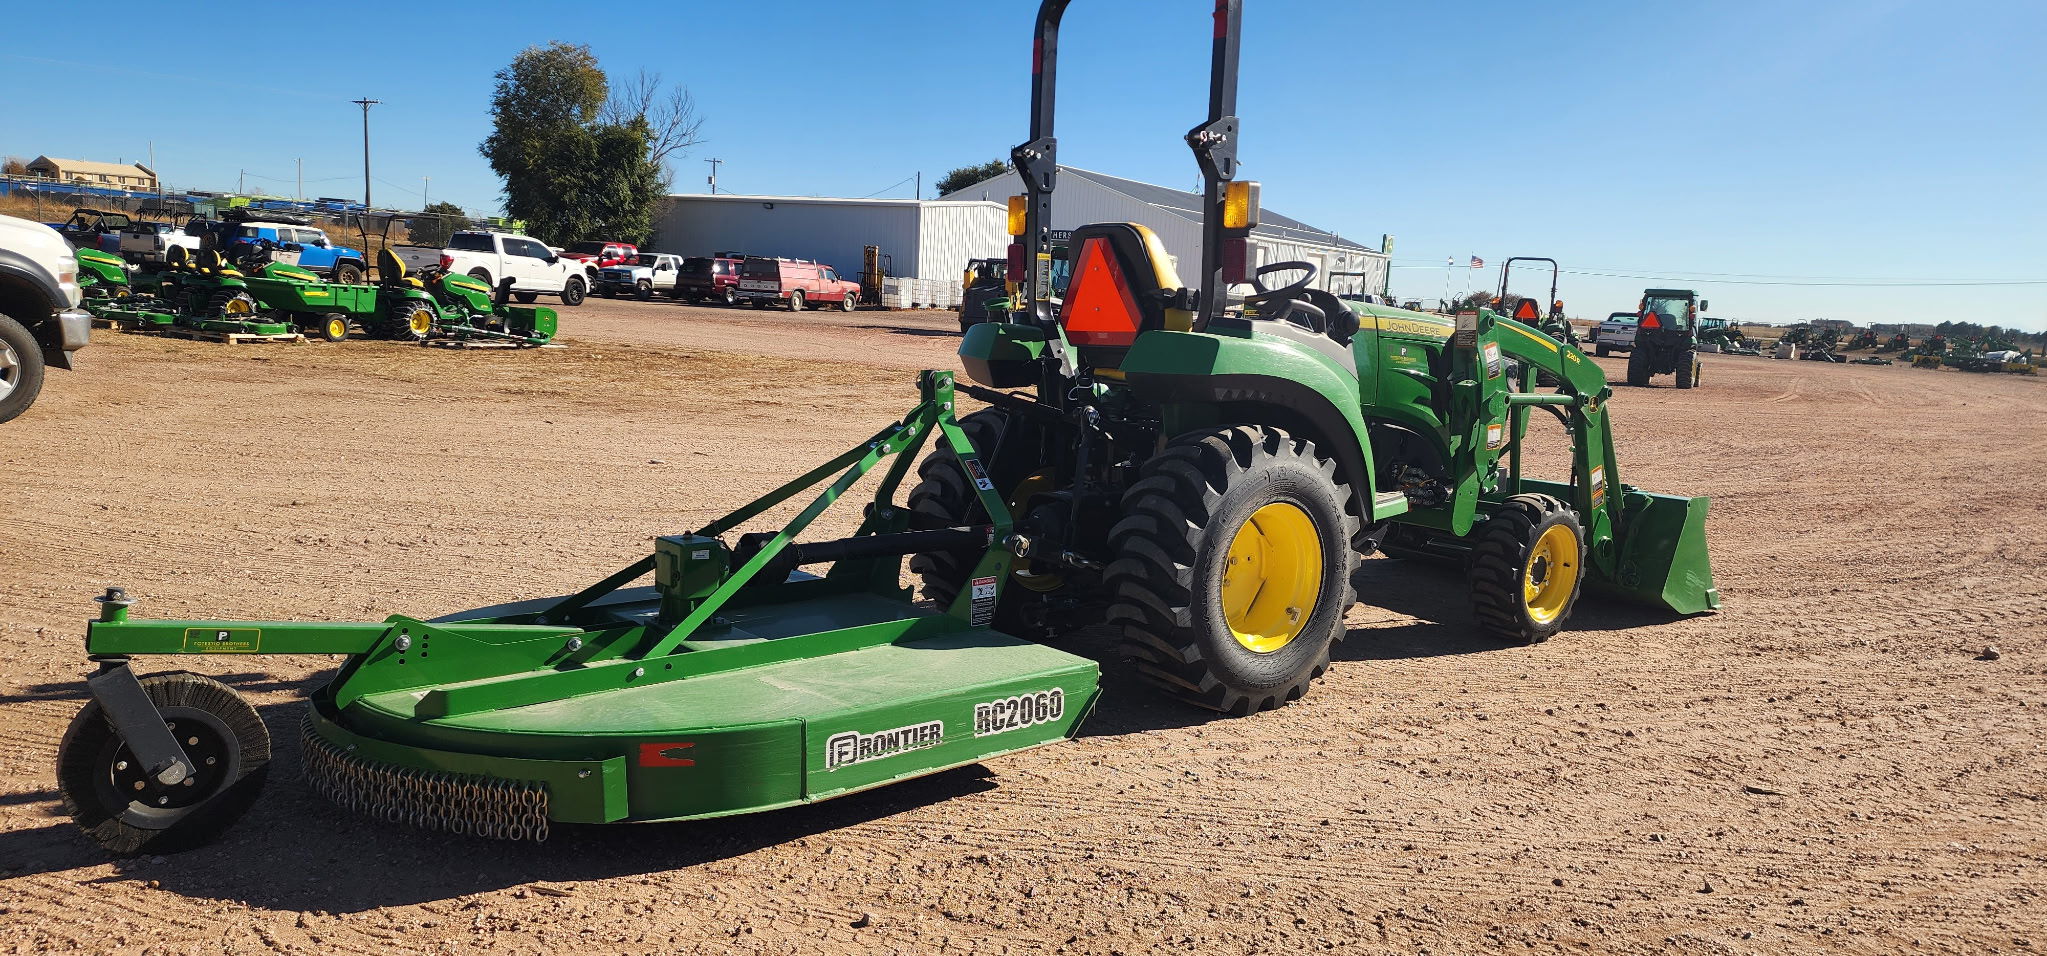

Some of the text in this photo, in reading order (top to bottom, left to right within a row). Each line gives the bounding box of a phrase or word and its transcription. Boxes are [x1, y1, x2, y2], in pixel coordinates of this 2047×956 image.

[1051, 231, 1072, 240] HERS
[1386, 320, 1441, 336] JOHN DEERE
[218, 631, 228, 640] P
[829, 690, 1063, 768] FRONTIER RC2060
